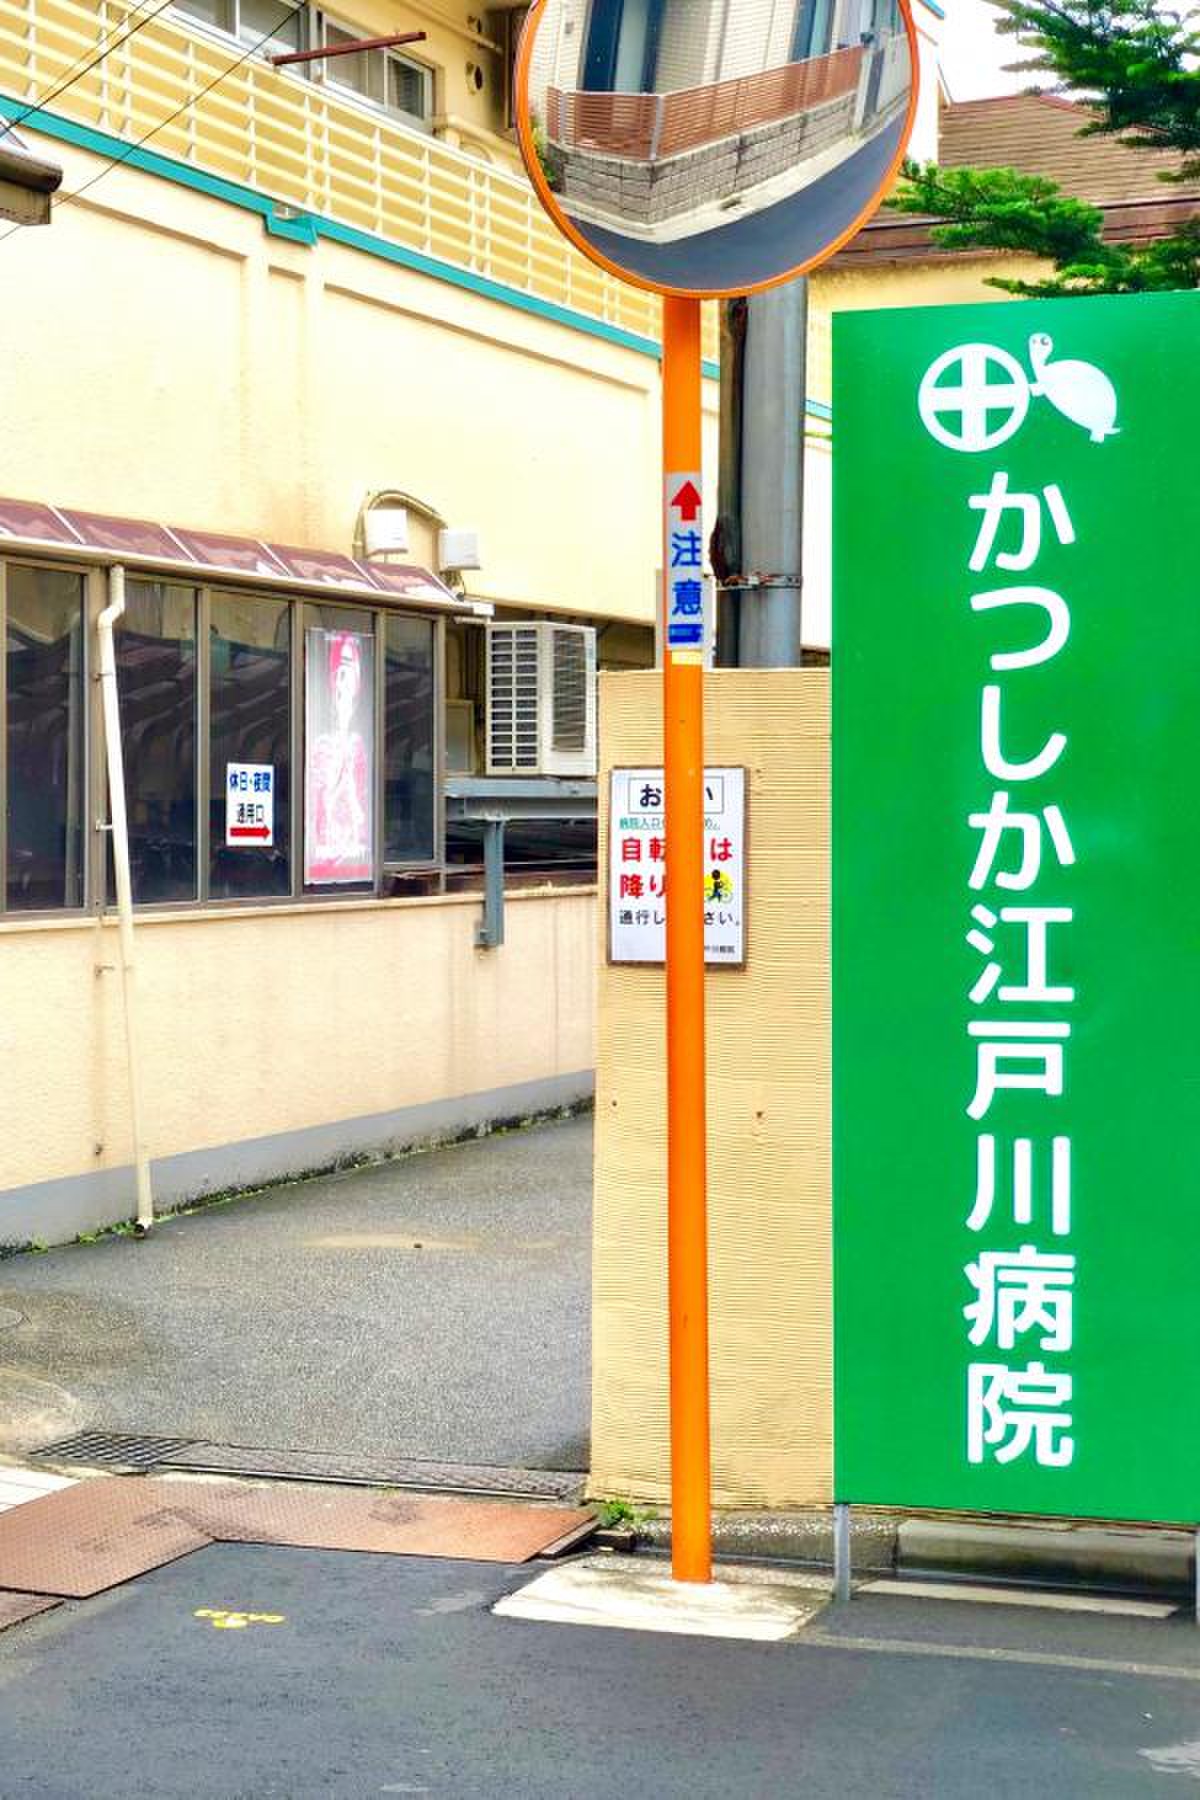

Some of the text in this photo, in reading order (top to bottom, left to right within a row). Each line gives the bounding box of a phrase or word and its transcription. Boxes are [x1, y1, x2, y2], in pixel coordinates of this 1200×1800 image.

[671, 529, 702, 616] 注意
[621, 836, 733, 863] 自転は
[619, 909, 741, 926] 通行しさい。
[964, 471, 1075, 1467] かつしか江戸川病院
